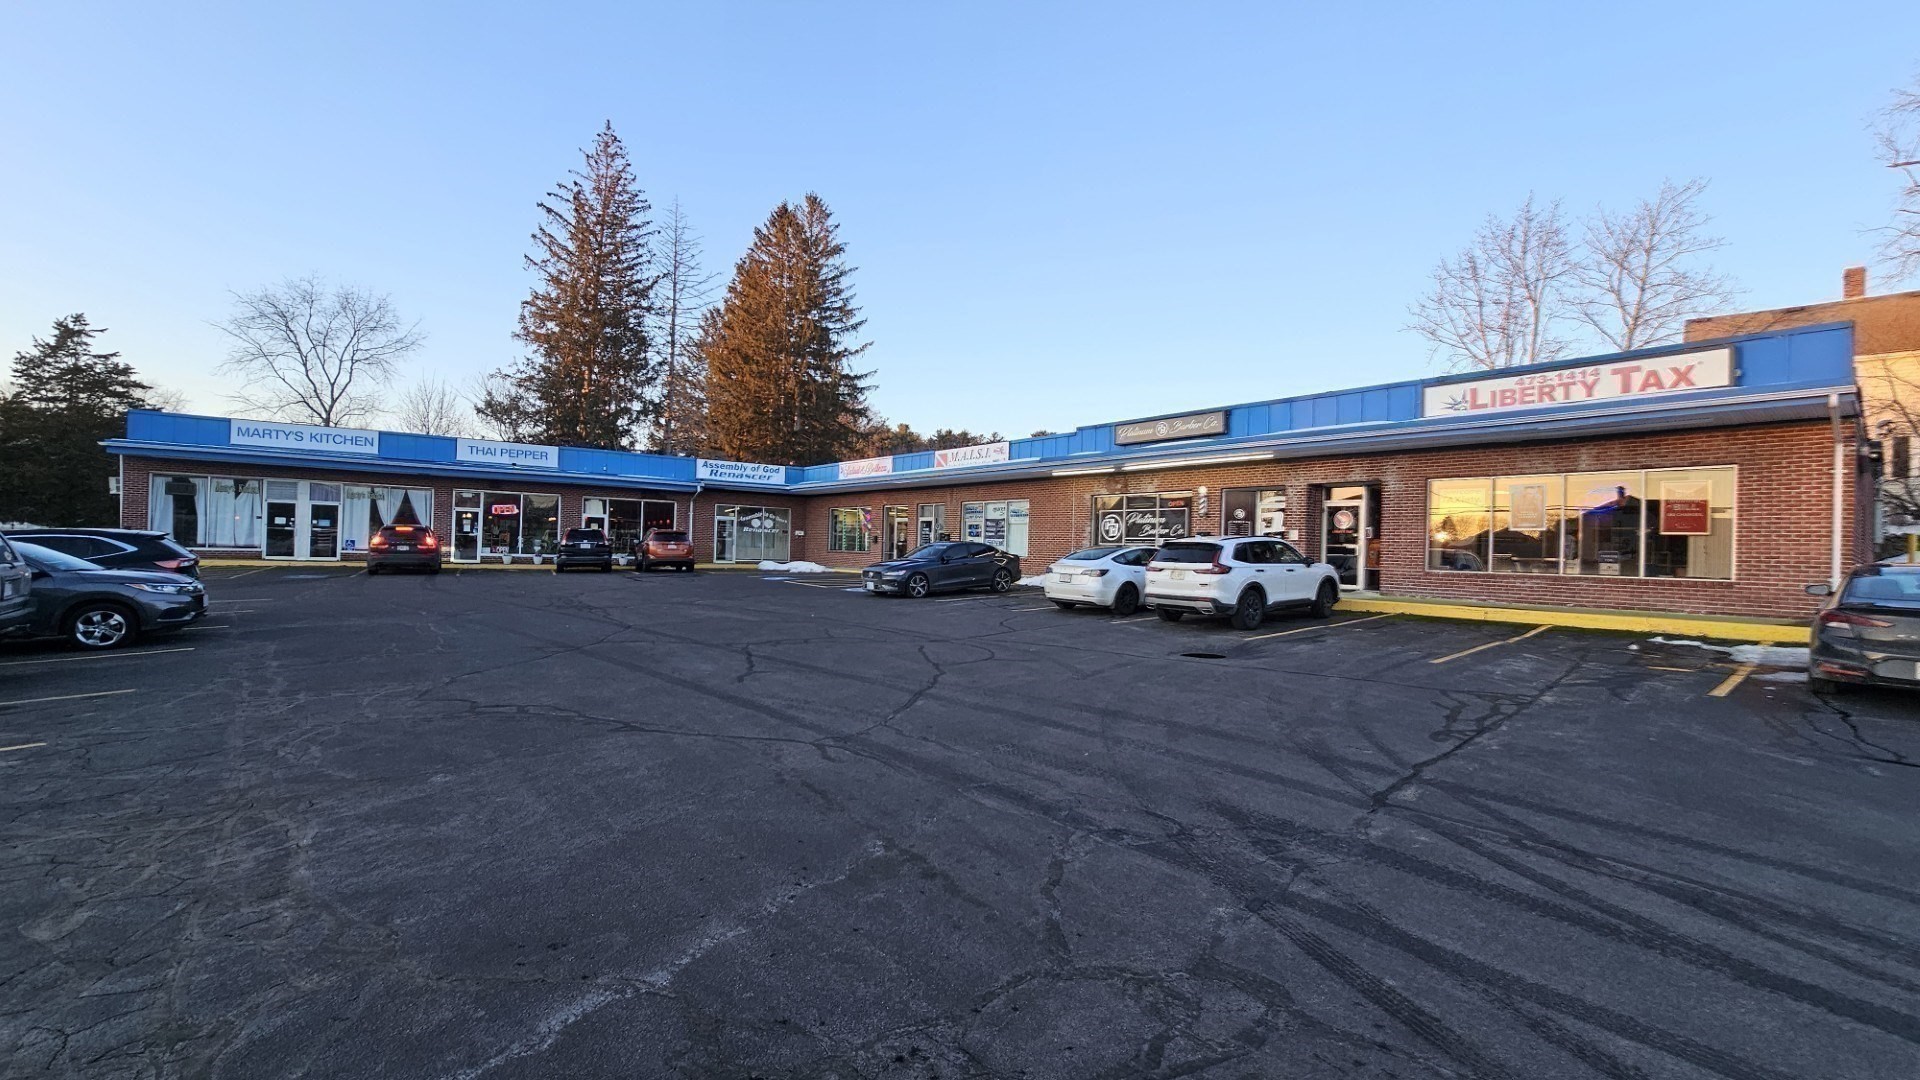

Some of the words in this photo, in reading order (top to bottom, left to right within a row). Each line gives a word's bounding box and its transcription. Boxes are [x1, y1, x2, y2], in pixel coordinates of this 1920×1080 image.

[1514, 367, 1600, 387] 473-1414
[1469, 377, 1600, 410] LIBERTY
[1610, 364, 1697, 395] TAX
[1118, 427, 1154, 439] Platinum
[1169, 420, 1201, 434] Barber
[1203, 416, 1219, 430] Co.
[236, 426, 304, 442] MARTY'S
[309, 432, 374, 447] KITCHEN
[467, 445, 497, 457] THAI
[500, 448, 549, 460] PEPPER
[702, 460, 748, 473] Assembly
[751, 464, 761, 473] of
[762, 465, 780, 474] God
[709, 469, 774, 481] Renascer
[493, 504, 517, 514] OPEN
[1168, 500, 1185, 508] OPEN
[1126, 511, 1166, 526] Platinum
[1138, 524, 1170, 536] Barber
